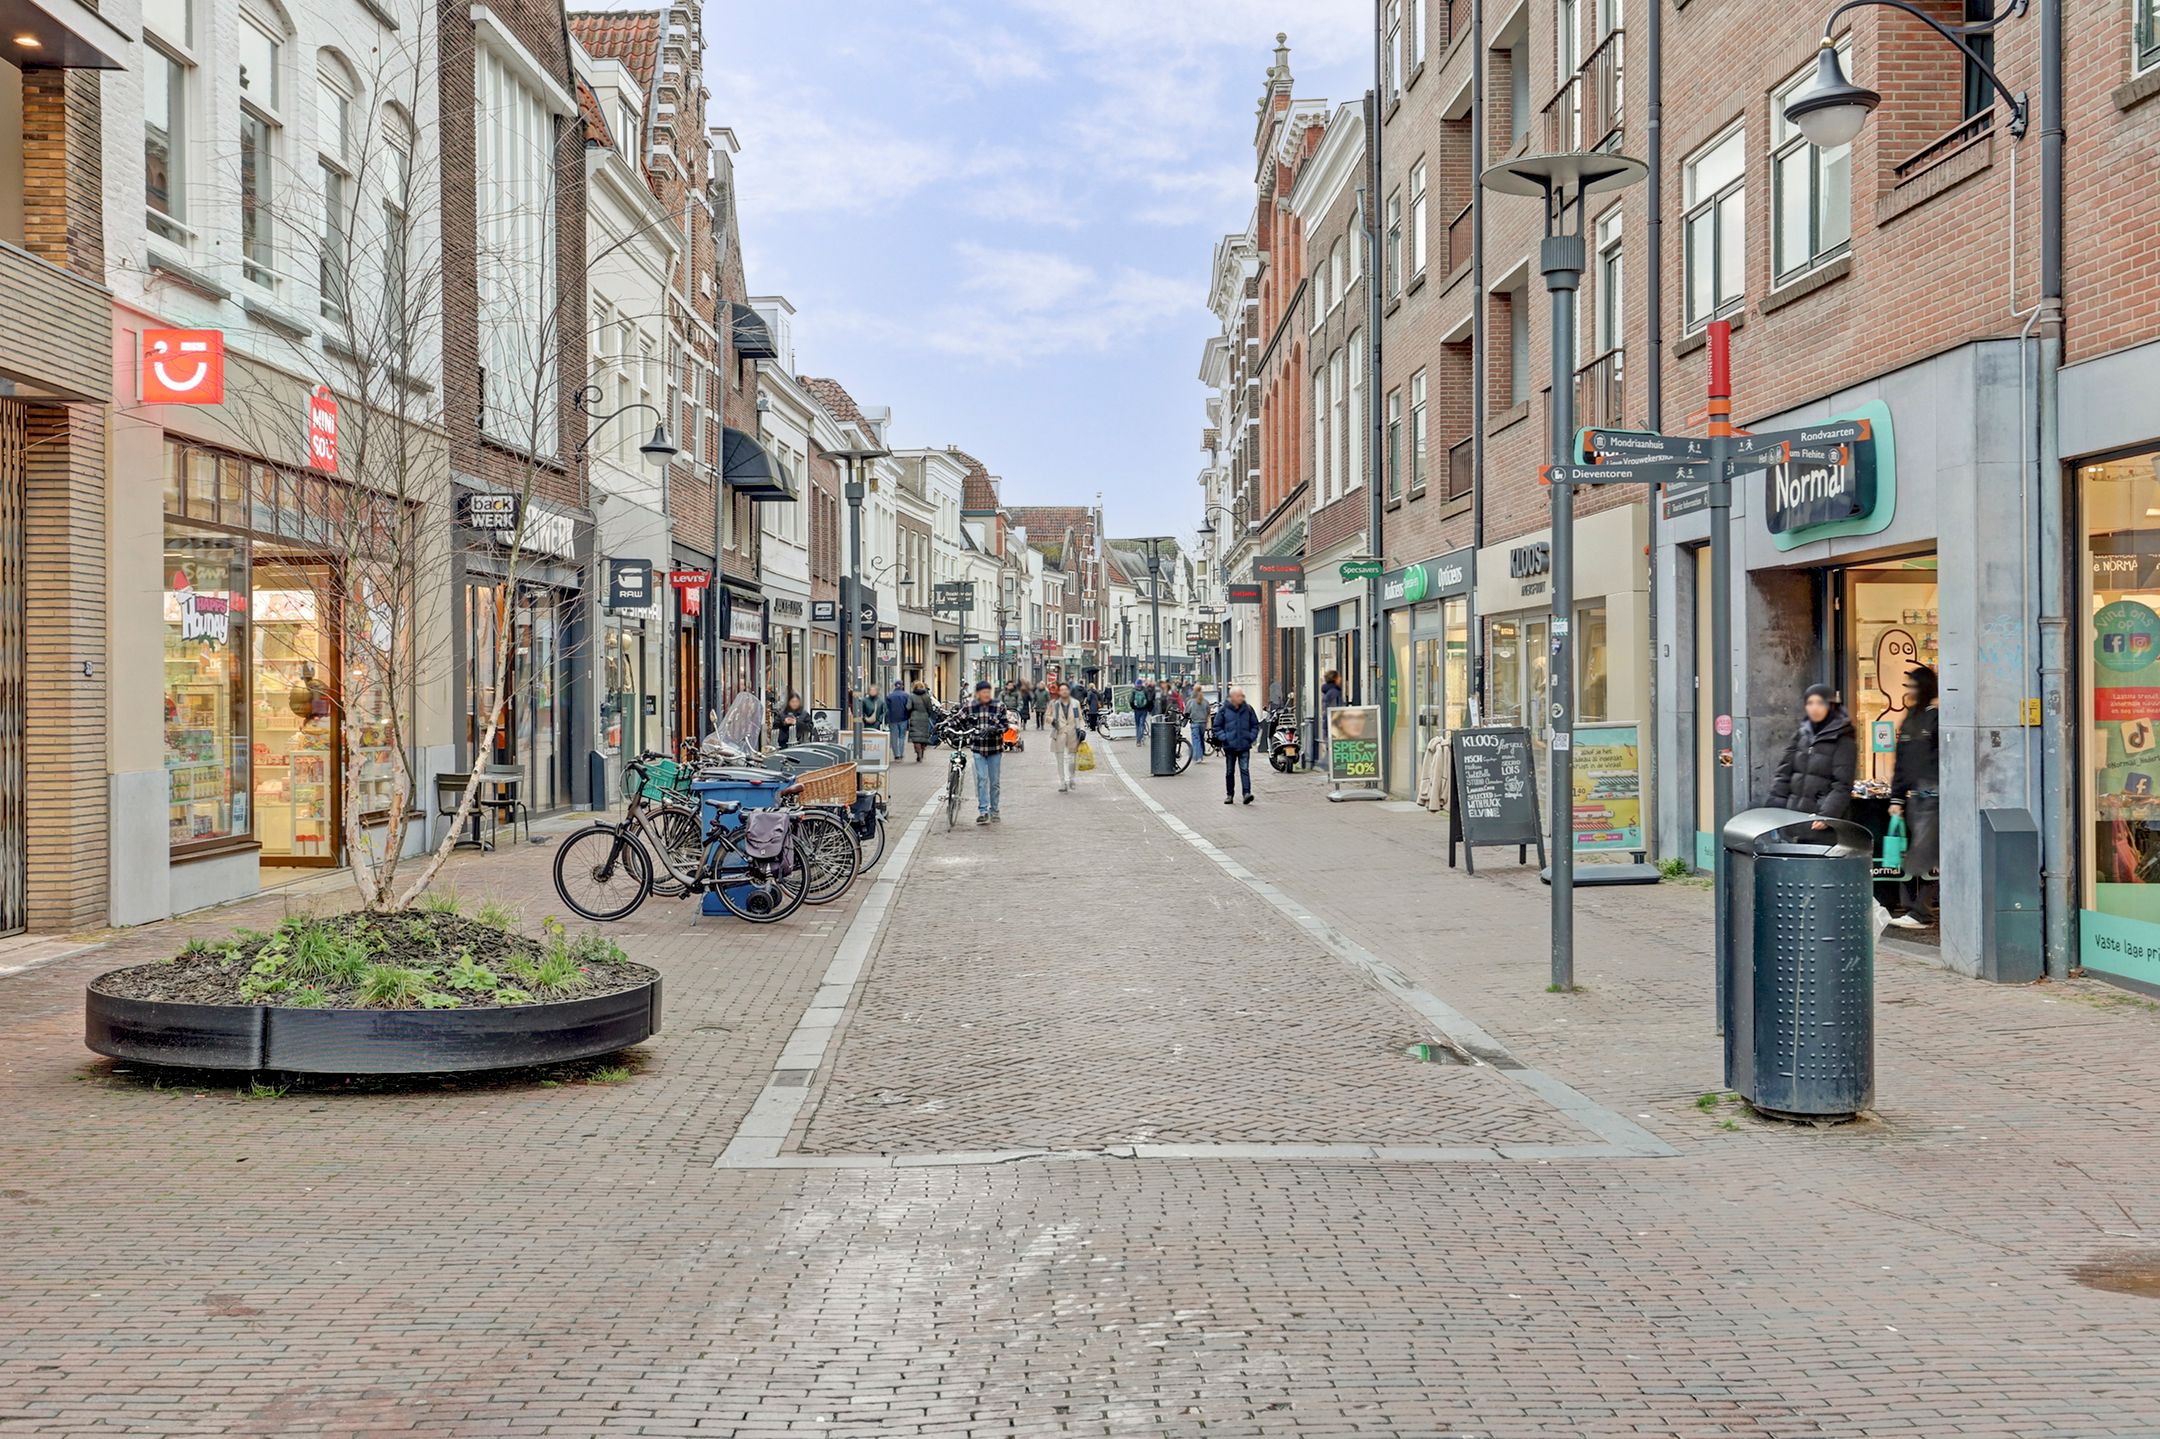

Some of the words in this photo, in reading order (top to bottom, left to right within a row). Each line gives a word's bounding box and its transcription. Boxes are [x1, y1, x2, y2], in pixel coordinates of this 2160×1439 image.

[1801, 427, 1855, 441] Rondvaarten
[1610, 436, 1665, 450] Mondriaanhuis
[1572, 469, 1633, 479] Dieventoren
[1775, 441, 1845, 513] Normal
[473, 497, 512, 510] back
[471, 512, 514, 527] WERK
[1510, 542, 1549, 578] KLOOS
[1343, 566, 1379, 575] Specsavers
[619, 590, 643, 598] RAW
[2097, 605, 2126, 628] Vind
[2130, 609, 2154, 628] ons
[2118, 620, 2134, 631] op
[1333, 741, 1364, 752] SPEC
[1462, 735, 1499, 747] KLOOS
[1333, 752, 1376, 763] FRIDAY
[1346, 763, 1375, 775] 50%
[1501, 766, 1520, 775] LOIS
[1468, 808, 1500, 818] ELVINE
[2095, 933, 2121, 952] Vaste
[2124, 938, 2144, 958] lage
